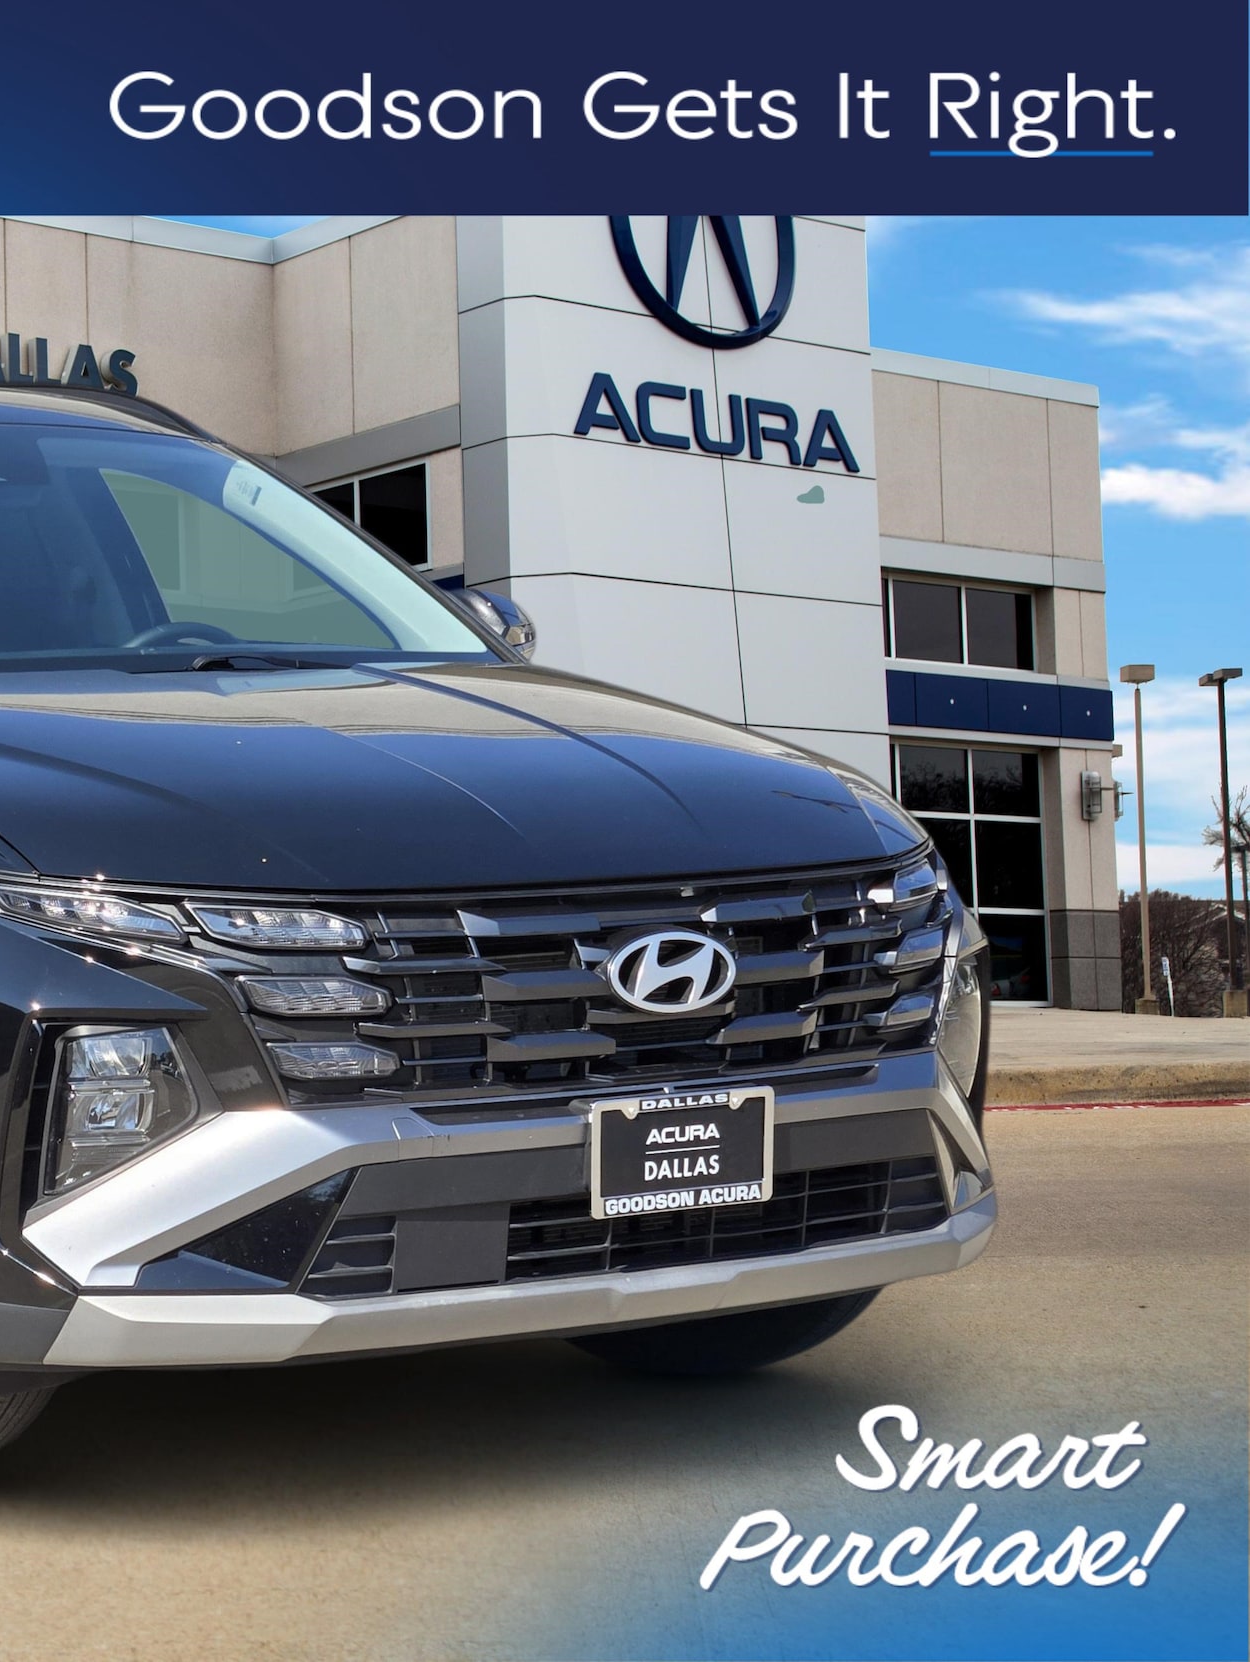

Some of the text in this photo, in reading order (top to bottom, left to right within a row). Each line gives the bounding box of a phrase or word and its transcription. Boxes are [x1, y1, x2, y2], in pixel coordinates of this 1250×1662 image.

[573, 372, 860, 473] ACURA
[642, 1093, 728, 1110] DALLAS
[646, 1123, 720, 1145] ACURA
[644, 1154, 720, 1182] DALLAS
[605, 1184, 761, 1215] GOODSON ACURA
